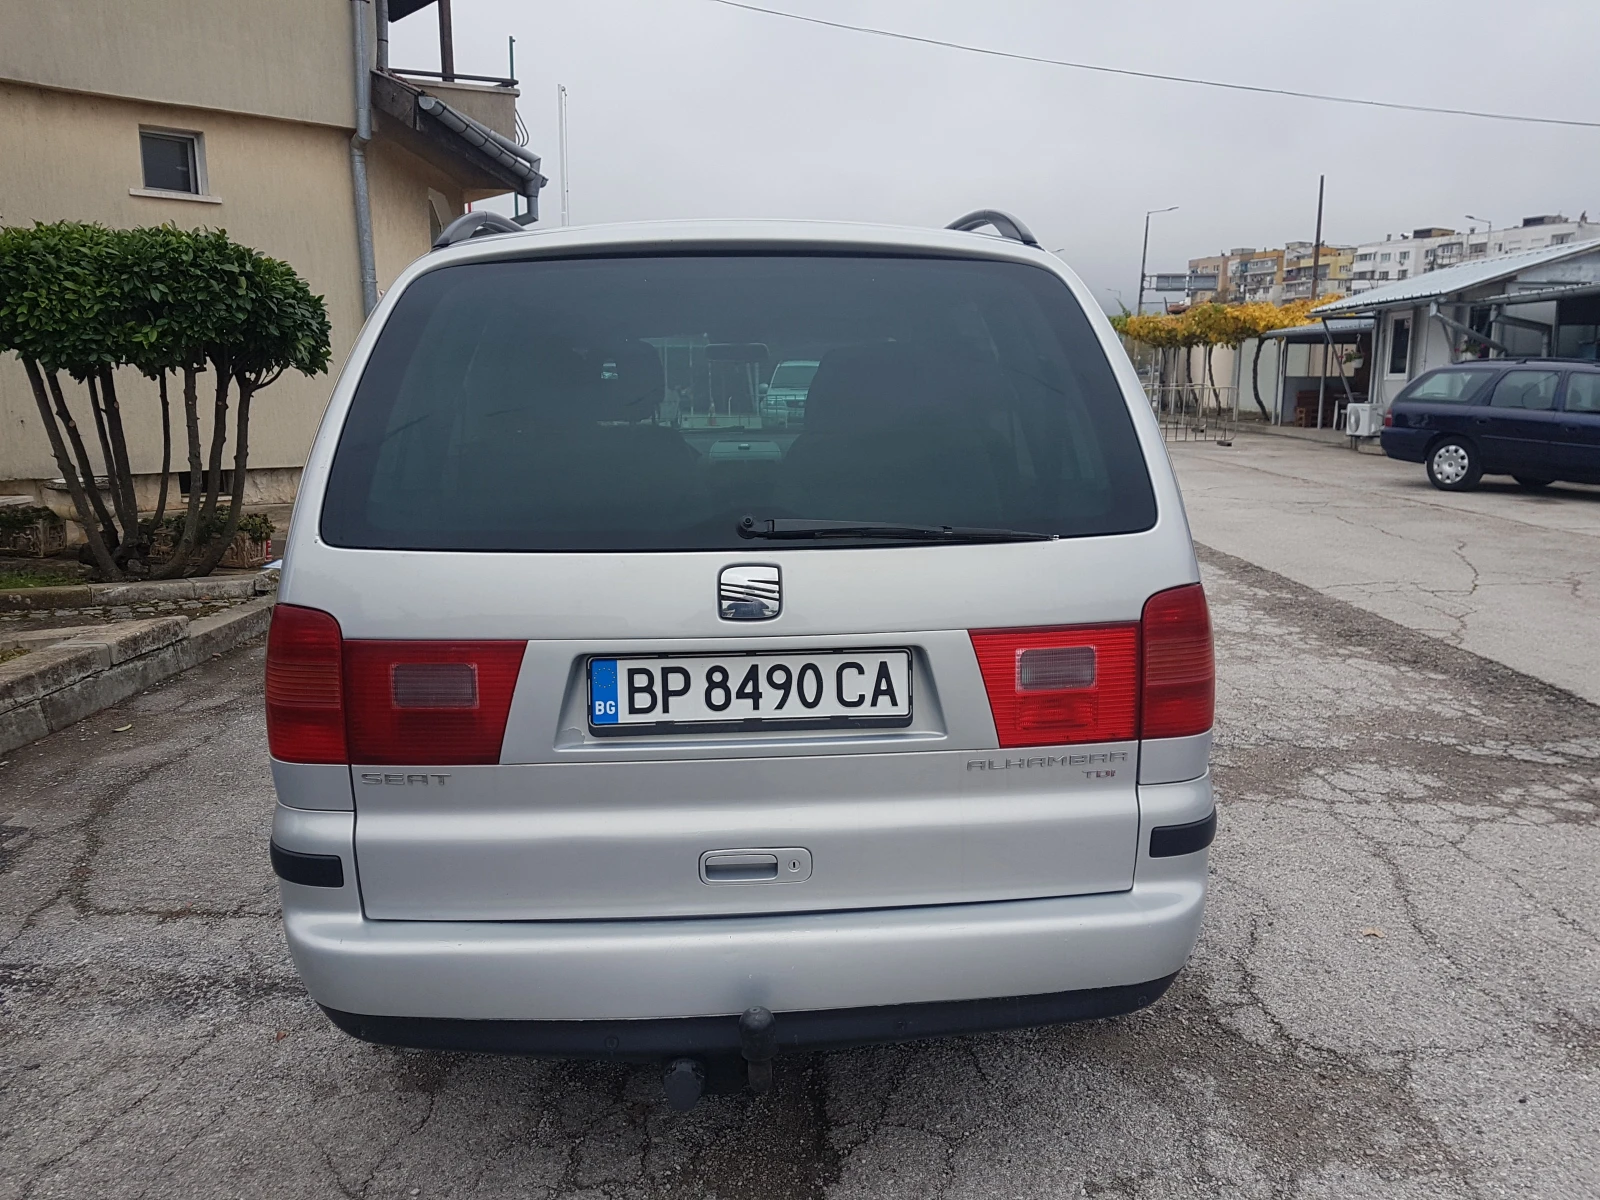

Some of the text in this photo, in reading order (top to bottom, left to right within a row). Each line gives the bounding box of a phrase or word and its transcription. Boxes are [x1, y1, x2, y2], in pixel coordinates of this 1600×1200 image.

[627, 661, 898, 714] BP 8490 CA
[595, 701, 616, 715] BG
[967, 751, 1128, 771] ALHAMBRA
[361, 772, 452, 786] SEAT
